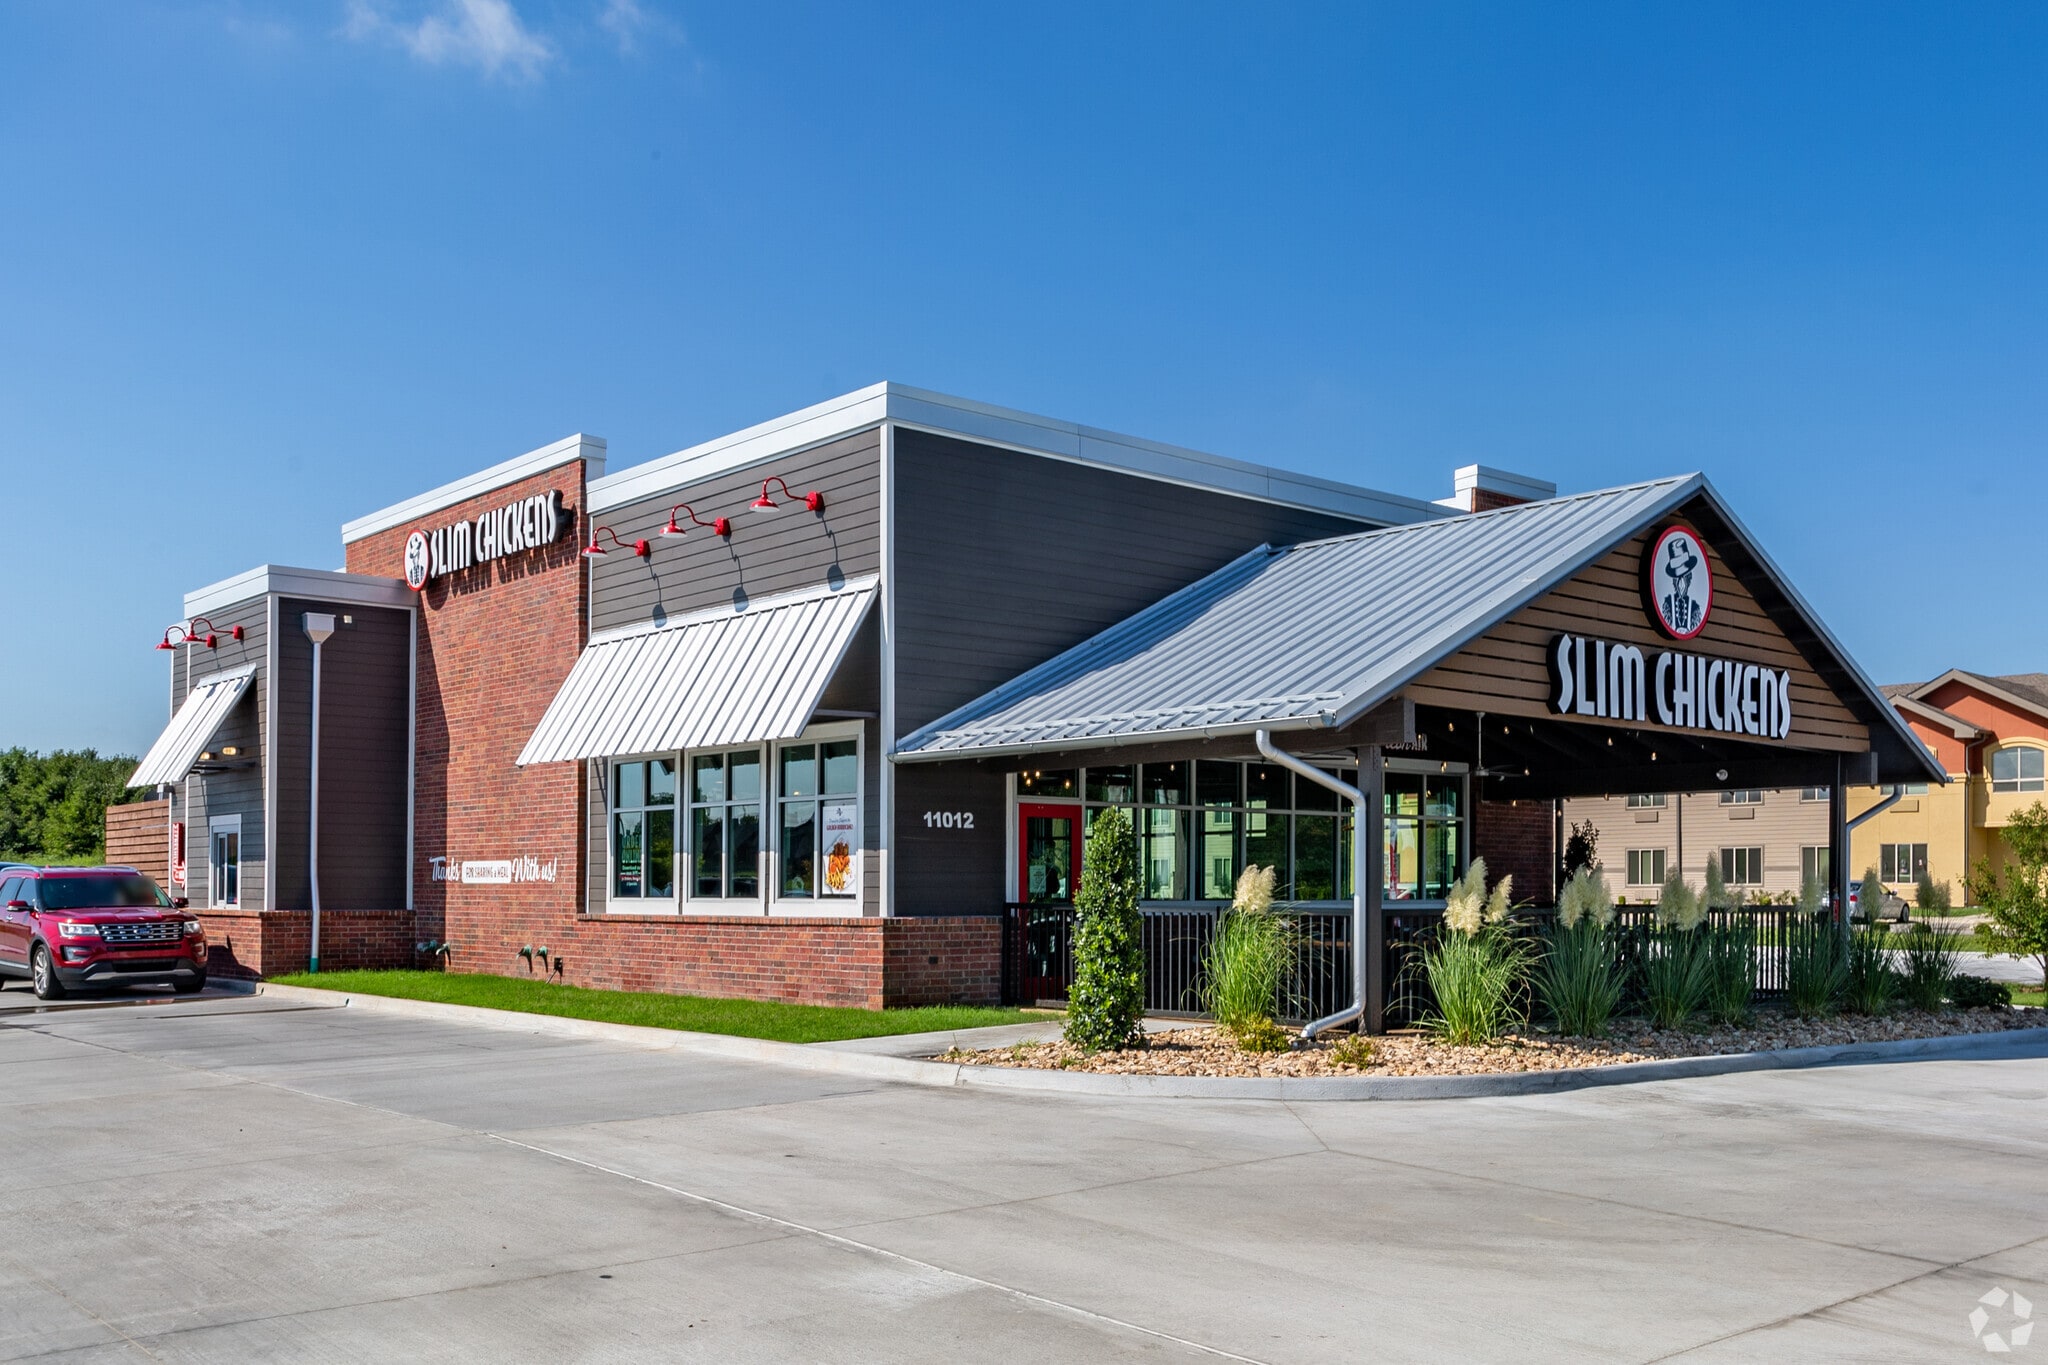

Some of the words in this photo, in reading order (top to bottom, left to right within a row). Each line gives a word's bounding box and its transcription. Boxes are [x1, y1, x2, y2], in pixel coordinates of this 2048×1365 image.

[430, 520, 471, 579] SLIM
[475, 489, 557, 563] CHICKENS
[1557, 633, 1646, 721] SLIM
[1655, 651, 1791, 740] CHICKENS
[923, 811, 975, 829] 11012
[429, 856, 460, 882] Thanks
[512, 855, 540, 882] With
[541, 857, 557, 882] us!
